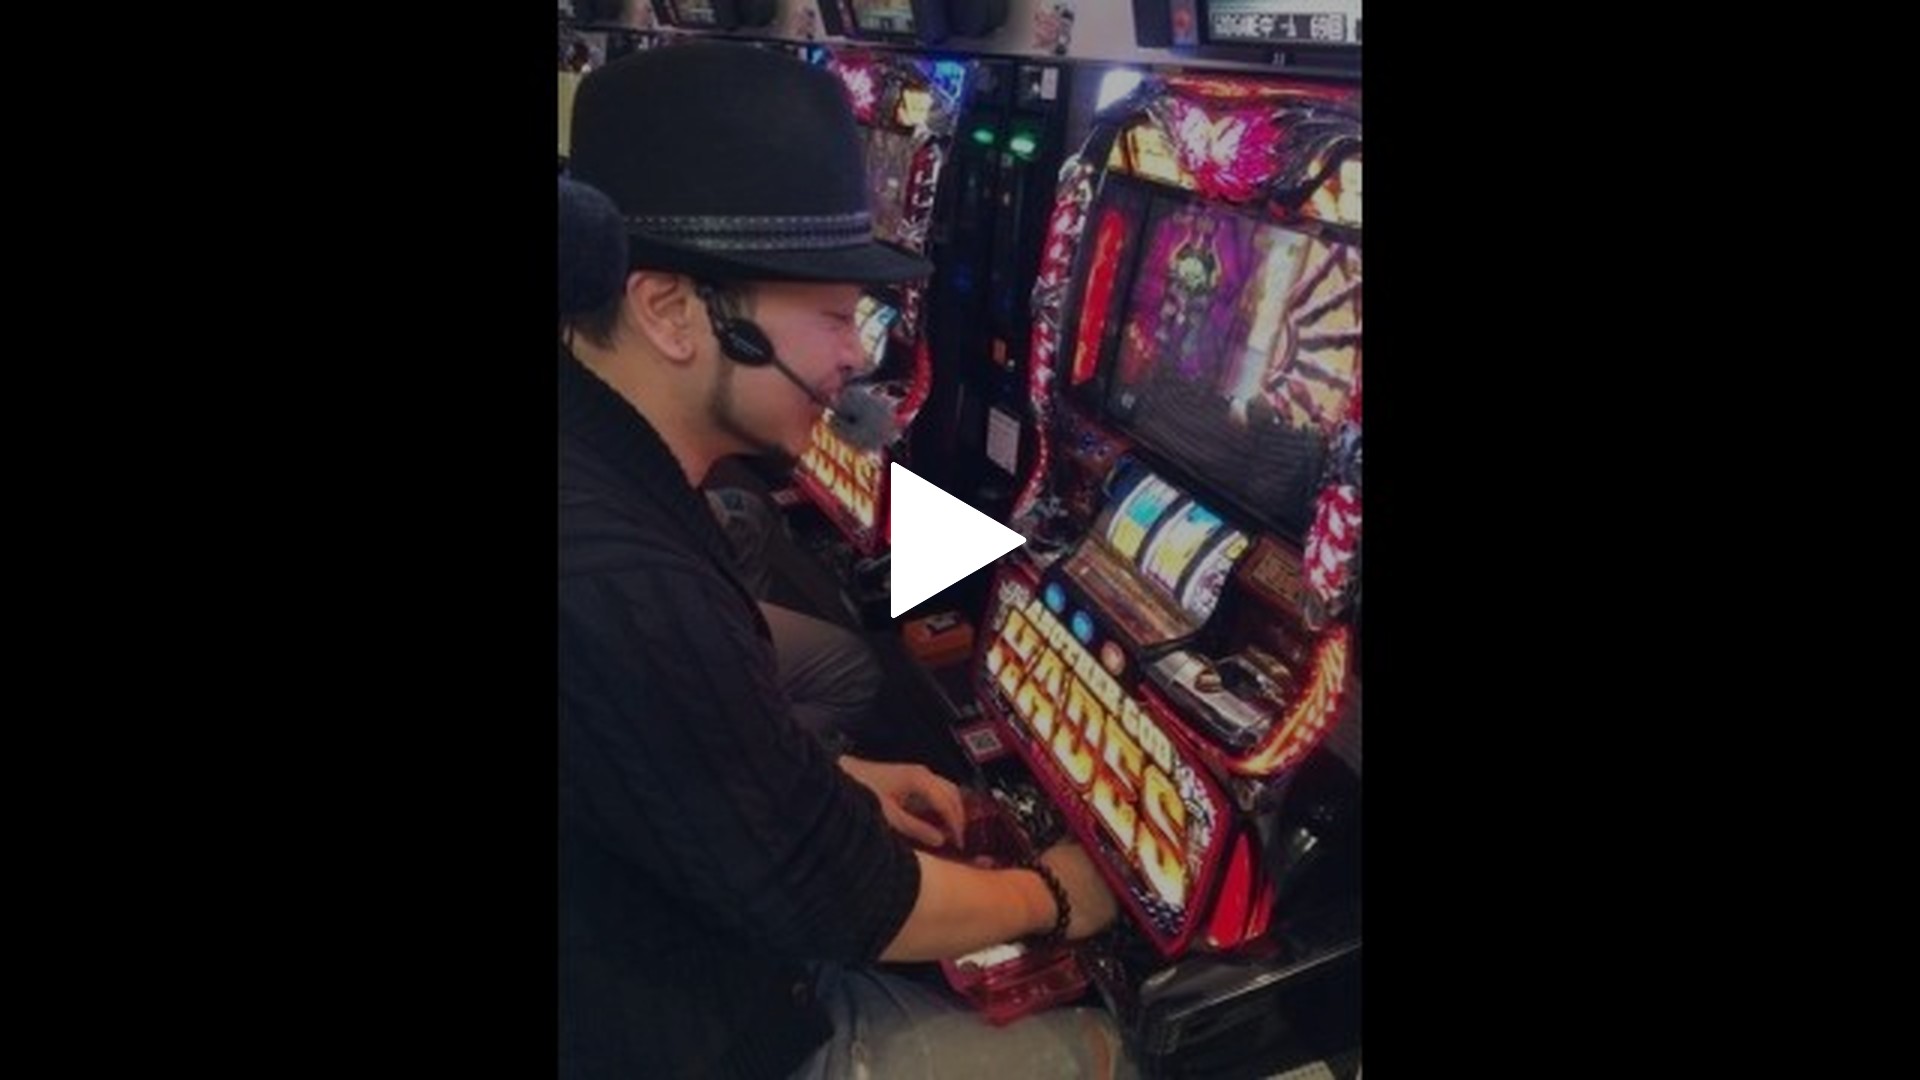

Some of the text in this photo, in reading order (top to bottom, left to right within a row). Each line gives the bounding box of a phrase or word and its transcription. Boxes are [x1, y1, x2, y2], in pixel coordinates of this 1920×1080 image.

[986, 607, 1187, 909] HADES
[1024, 599, 1175, 775] ANOTHER GOD
